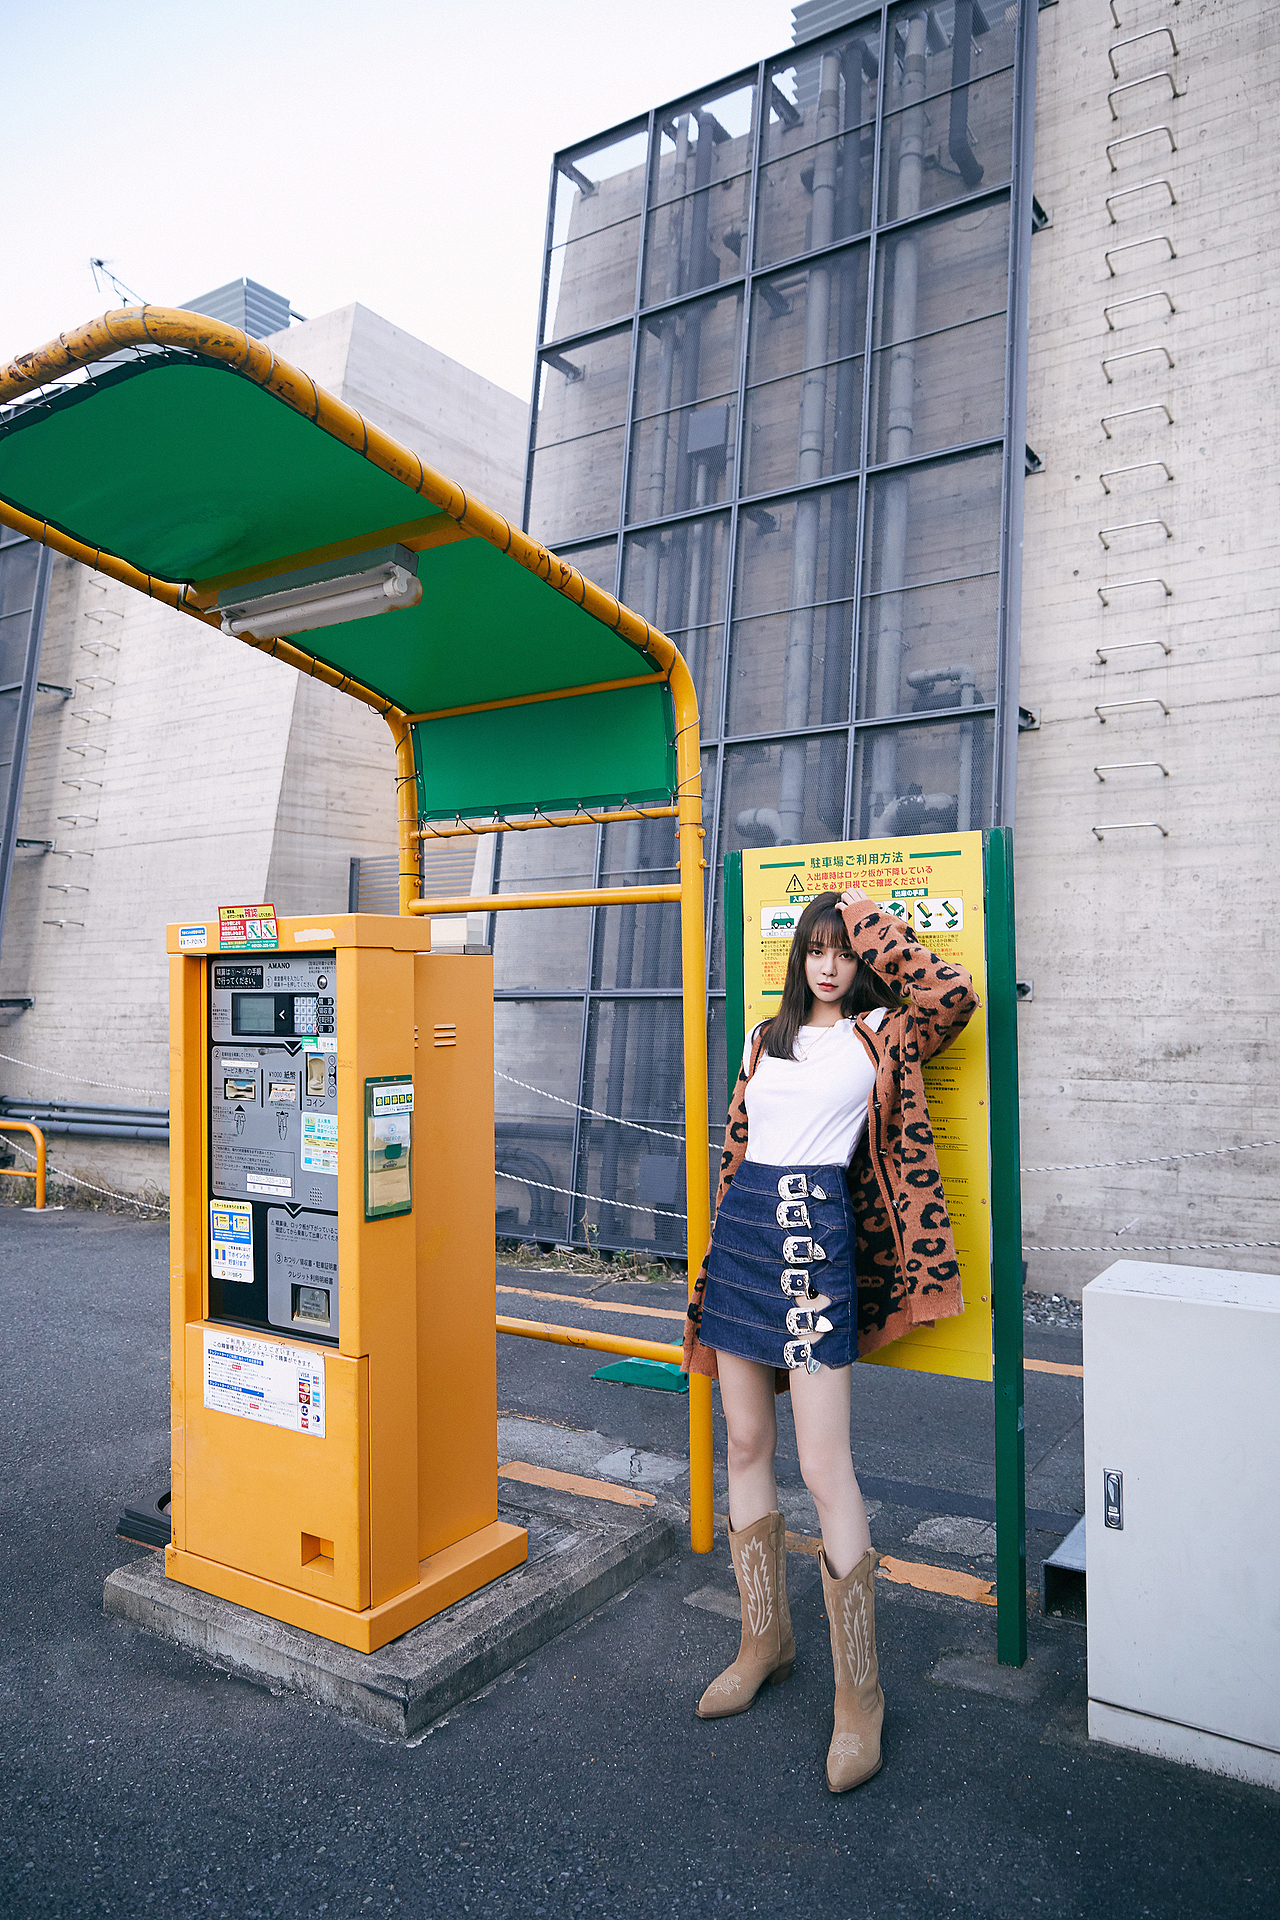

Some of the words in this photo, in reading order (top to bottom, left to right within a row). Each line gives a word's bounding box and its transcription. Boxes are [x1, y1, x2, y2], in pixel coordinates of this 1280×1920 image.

[810, 852, 903, 869] 駐車場ご利用方法
[806, 865, 933, 881] 入出庫時はロック板が下降している
[793, 895, 818, 904] 入庫の手
[267, 962, 291, 970] AMANO
[306, 1098, 325, 1107] コイン
